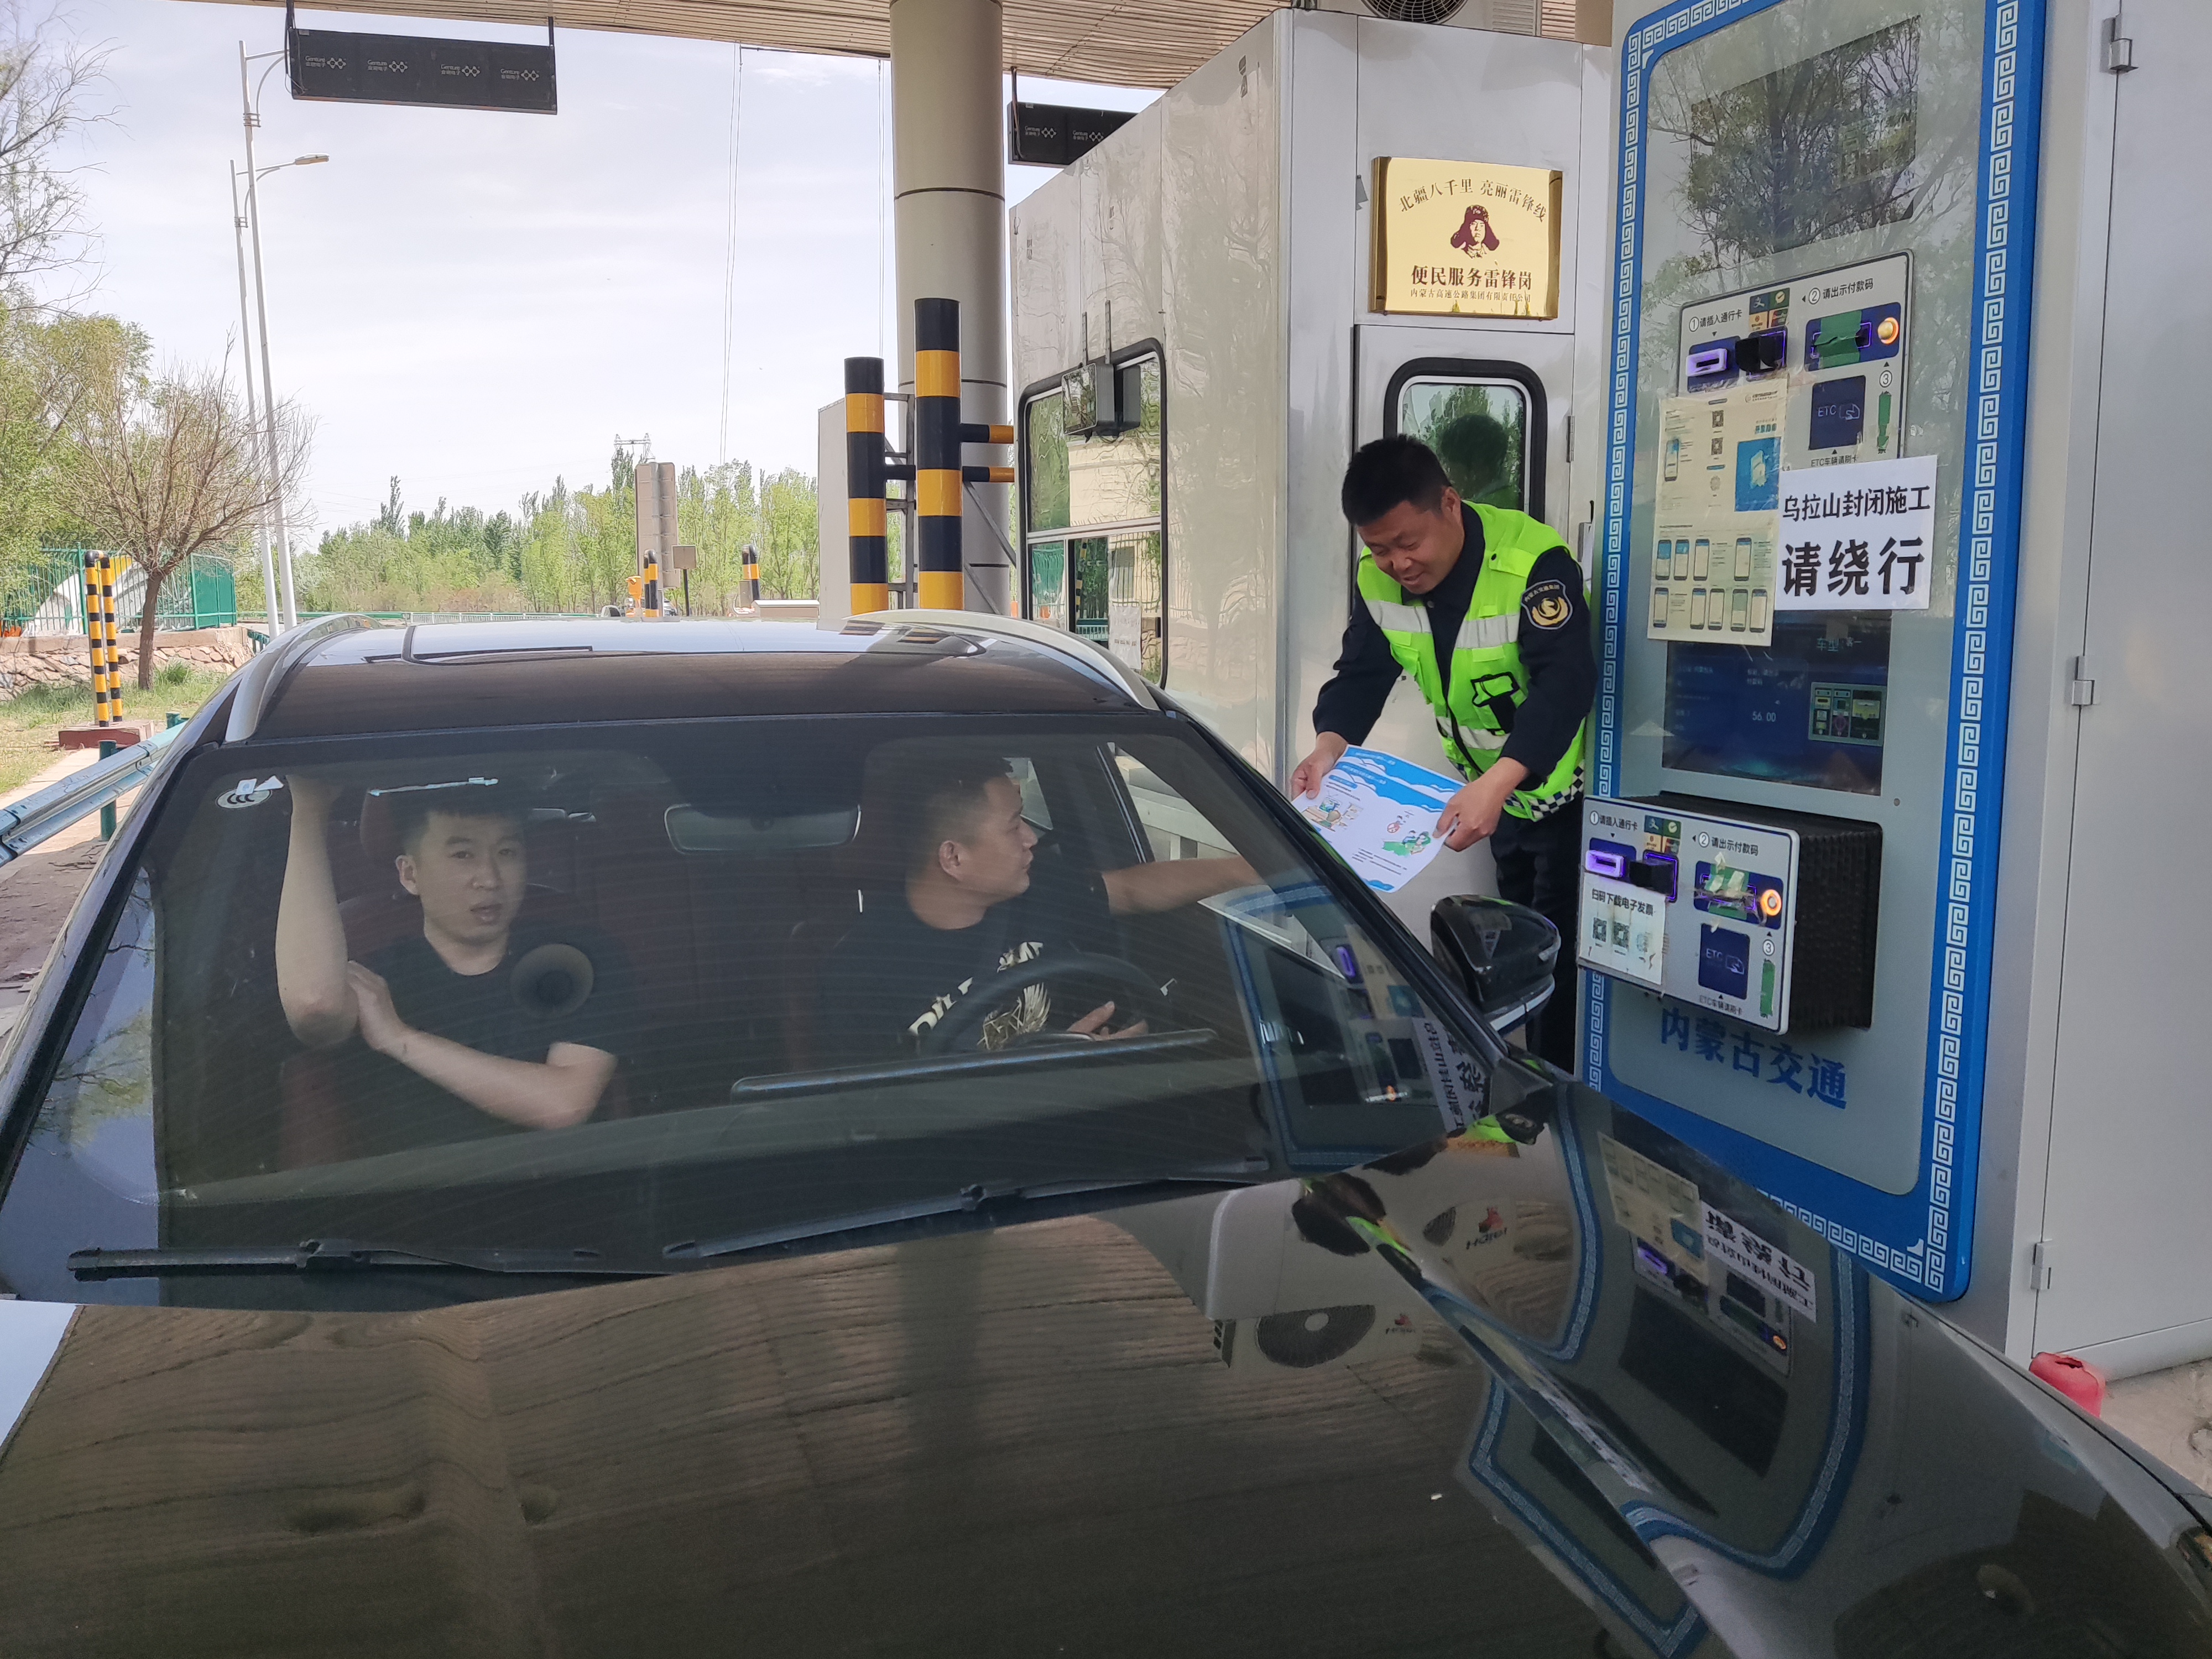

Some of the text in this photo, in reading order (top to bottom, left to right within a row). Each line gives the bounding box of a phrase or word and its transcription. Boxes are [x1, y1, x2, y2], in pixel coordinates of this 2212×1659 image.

[1399, 178, 1547, 222] 北疆八千里 亮丽雷锋线
[1411, 265, 1531, 290] 便民服务雷锋岗
[1818, 405, 1837, 418] ETC
[1782, 485, 1931, 522] 乌拉山封闭施工
[1782, 536, 1925, 597] 请绕行
[1706, 948, 1723, 959] ETC
[1661, 1007, 1847, 1109] 内蒙古交通
